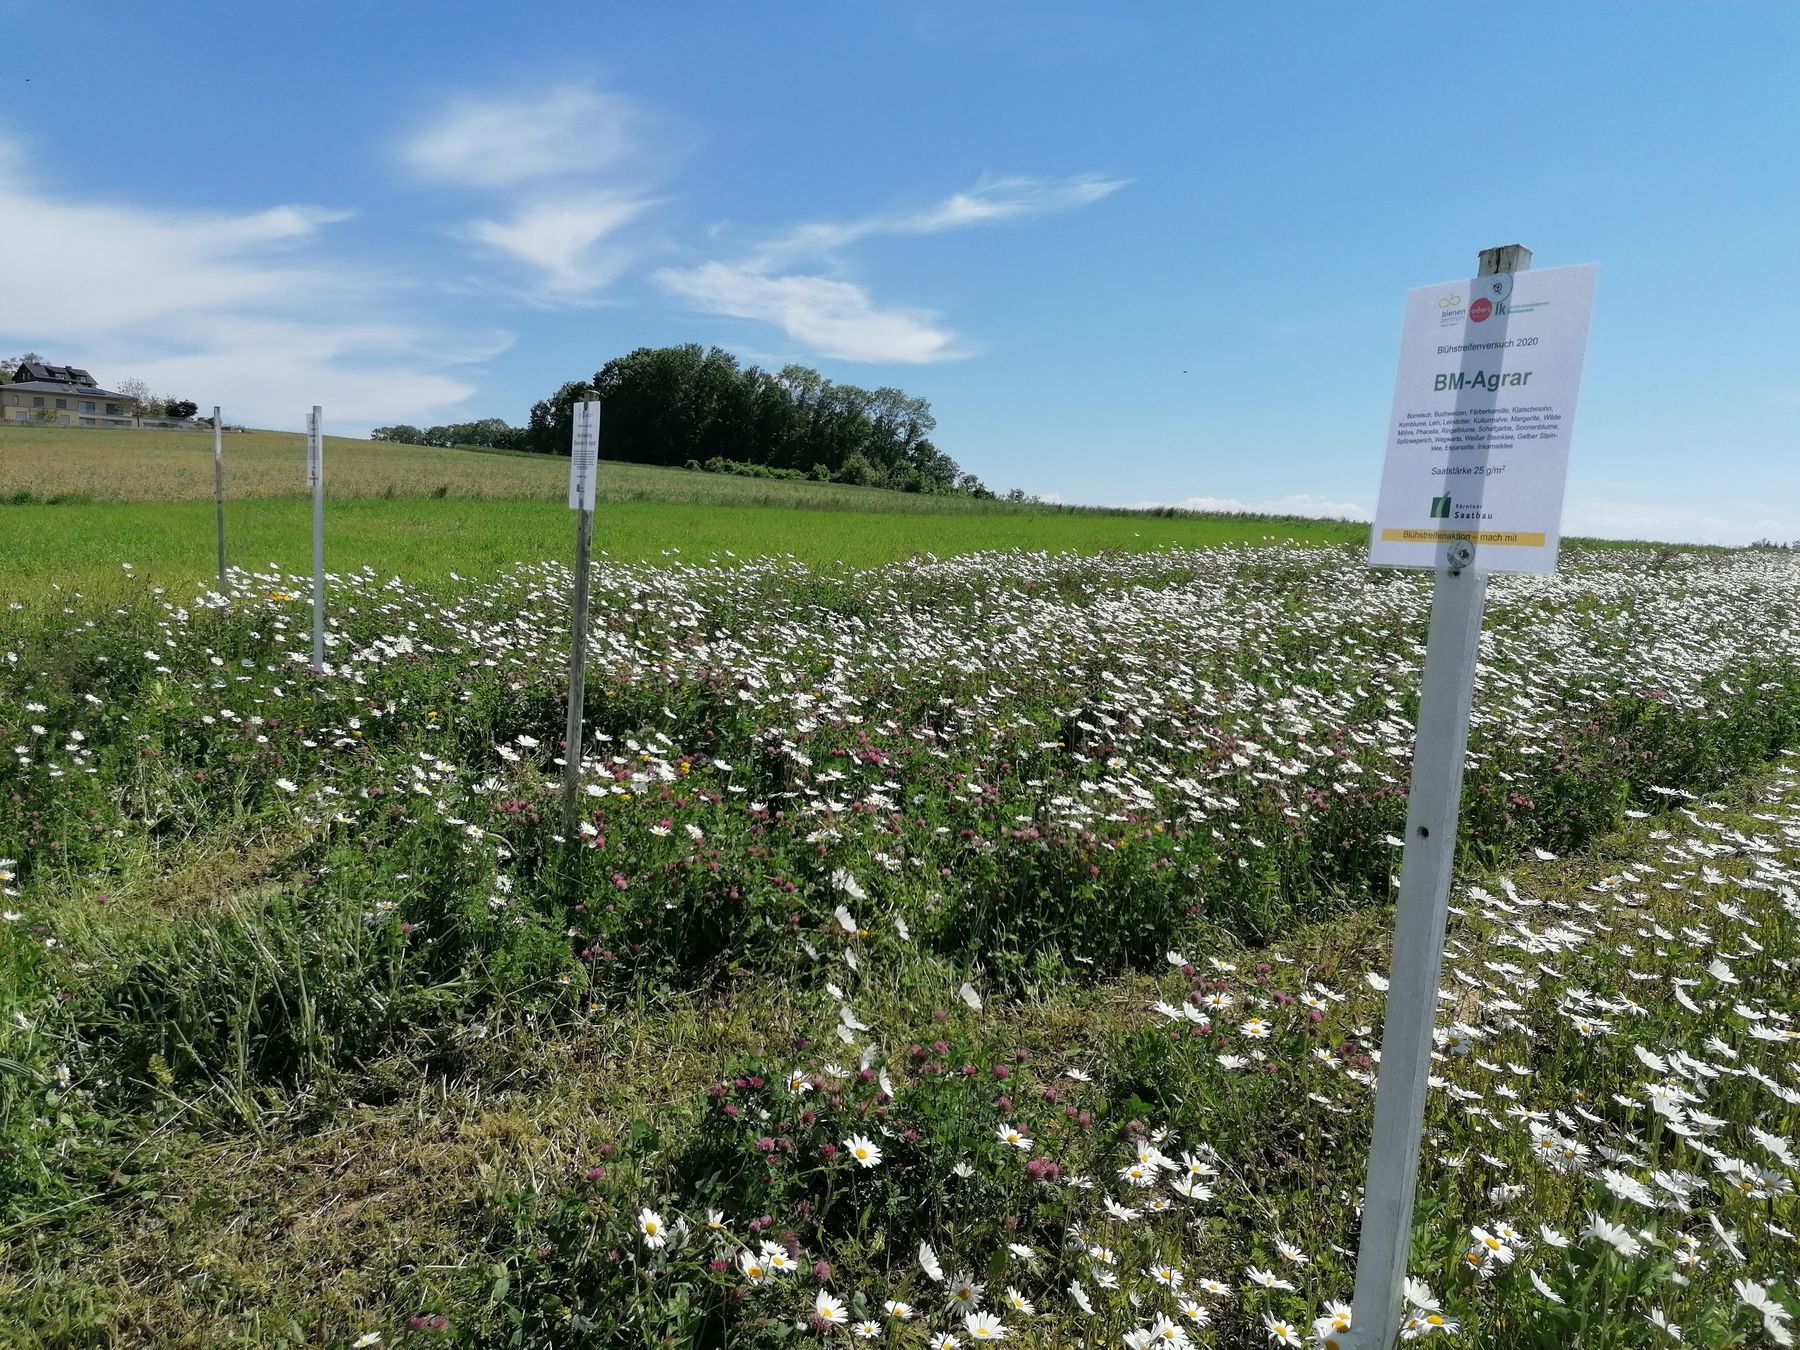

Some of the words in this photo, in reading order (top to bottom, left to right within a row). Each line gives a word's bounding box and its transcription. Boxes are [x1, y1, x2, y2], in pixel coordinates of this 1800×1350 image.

[1442, 309, 1466, 317] bienen
[1437, 339, 1514, 354] Blühstreifenversuch
[1516, 337, 1539, 347] 2020
[1433, 370, 1533, 392] BM-Agrar
[1511, 415, 1541, 423] Margerite,
[1431, 466, 1472, 475] Saatstärke
[1474, 466, 1484, 474] 25
[1454, 511, 1493, 520] Saatbau
[1403, 530, 1471, 541] Blühstreifenaktion
[1480, 533, 1502, 542] mach
[1504, 534, 1518, 542] mit
